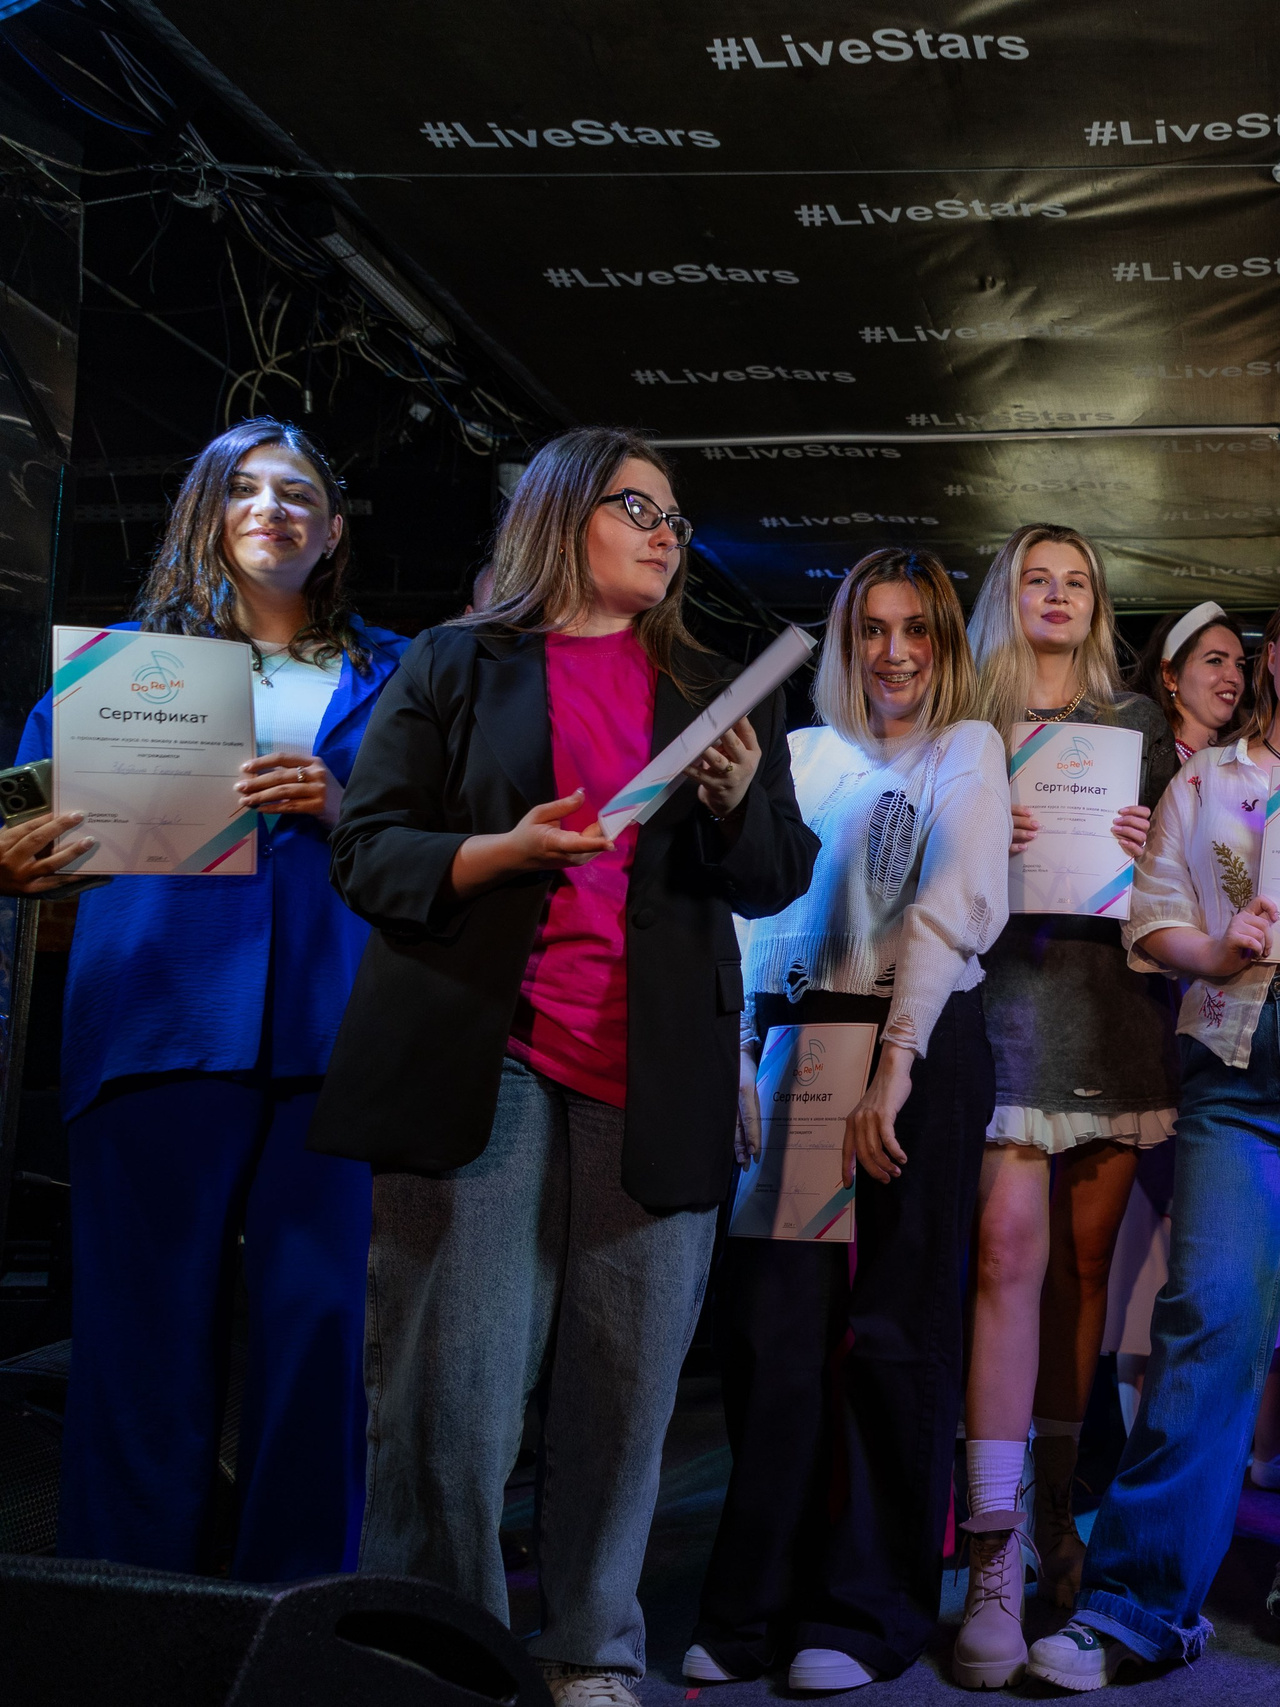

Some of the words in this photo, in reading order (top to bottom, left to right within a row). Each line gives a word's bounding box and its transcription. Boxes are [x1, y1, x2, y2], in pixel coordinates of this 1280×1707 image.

[706, 28, 1030, 71] #LiveStars
[419, 119, 721, 149] #LiveStars
[794, 198, 1068, 227] #LiveStars
[543, 262, 800, 289] #LiveStars
[858, 322, 1095, 343] #LiveStars
[630, 365, 857, 386] #LiveStars
[905, 410, 1116, 427] #LiveStars
[700, 443, 902, 461] #LiveStars
[759, 512, 940, 528] #LiveStars
[99, 707, 209, 724] Сертификат
[1035, 781, 1108, 796] Сертификат
[772, 1091, 833, 1104] Сертификат
